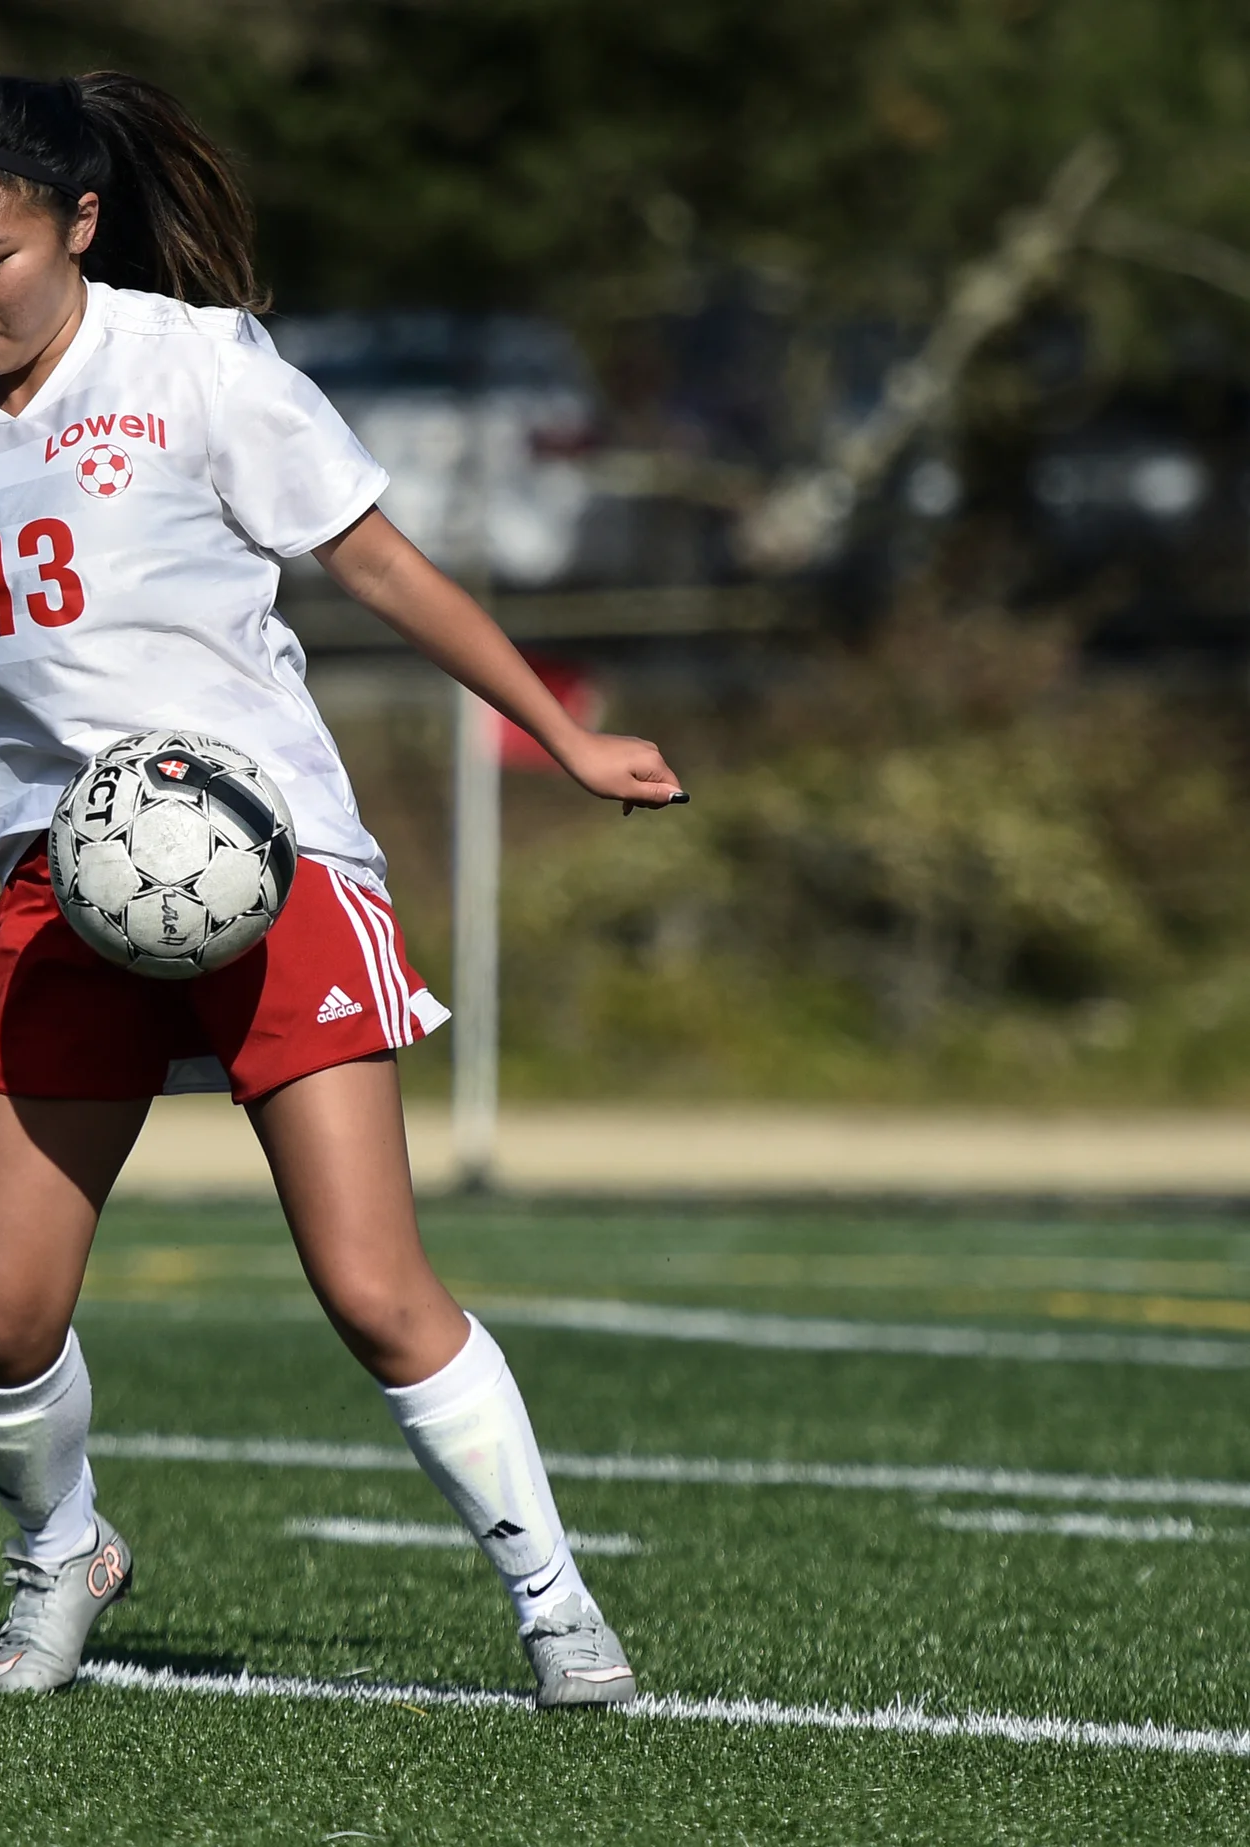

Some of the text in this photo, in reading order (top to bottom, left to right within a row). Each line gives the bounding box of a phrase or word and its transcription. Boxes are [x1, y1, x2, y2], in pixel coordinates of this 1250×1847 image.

[45, 413, 166, 464] Lowell
[157, 892, 188, 946] Lowell
[316, 1002, 363, 1024] adidas
